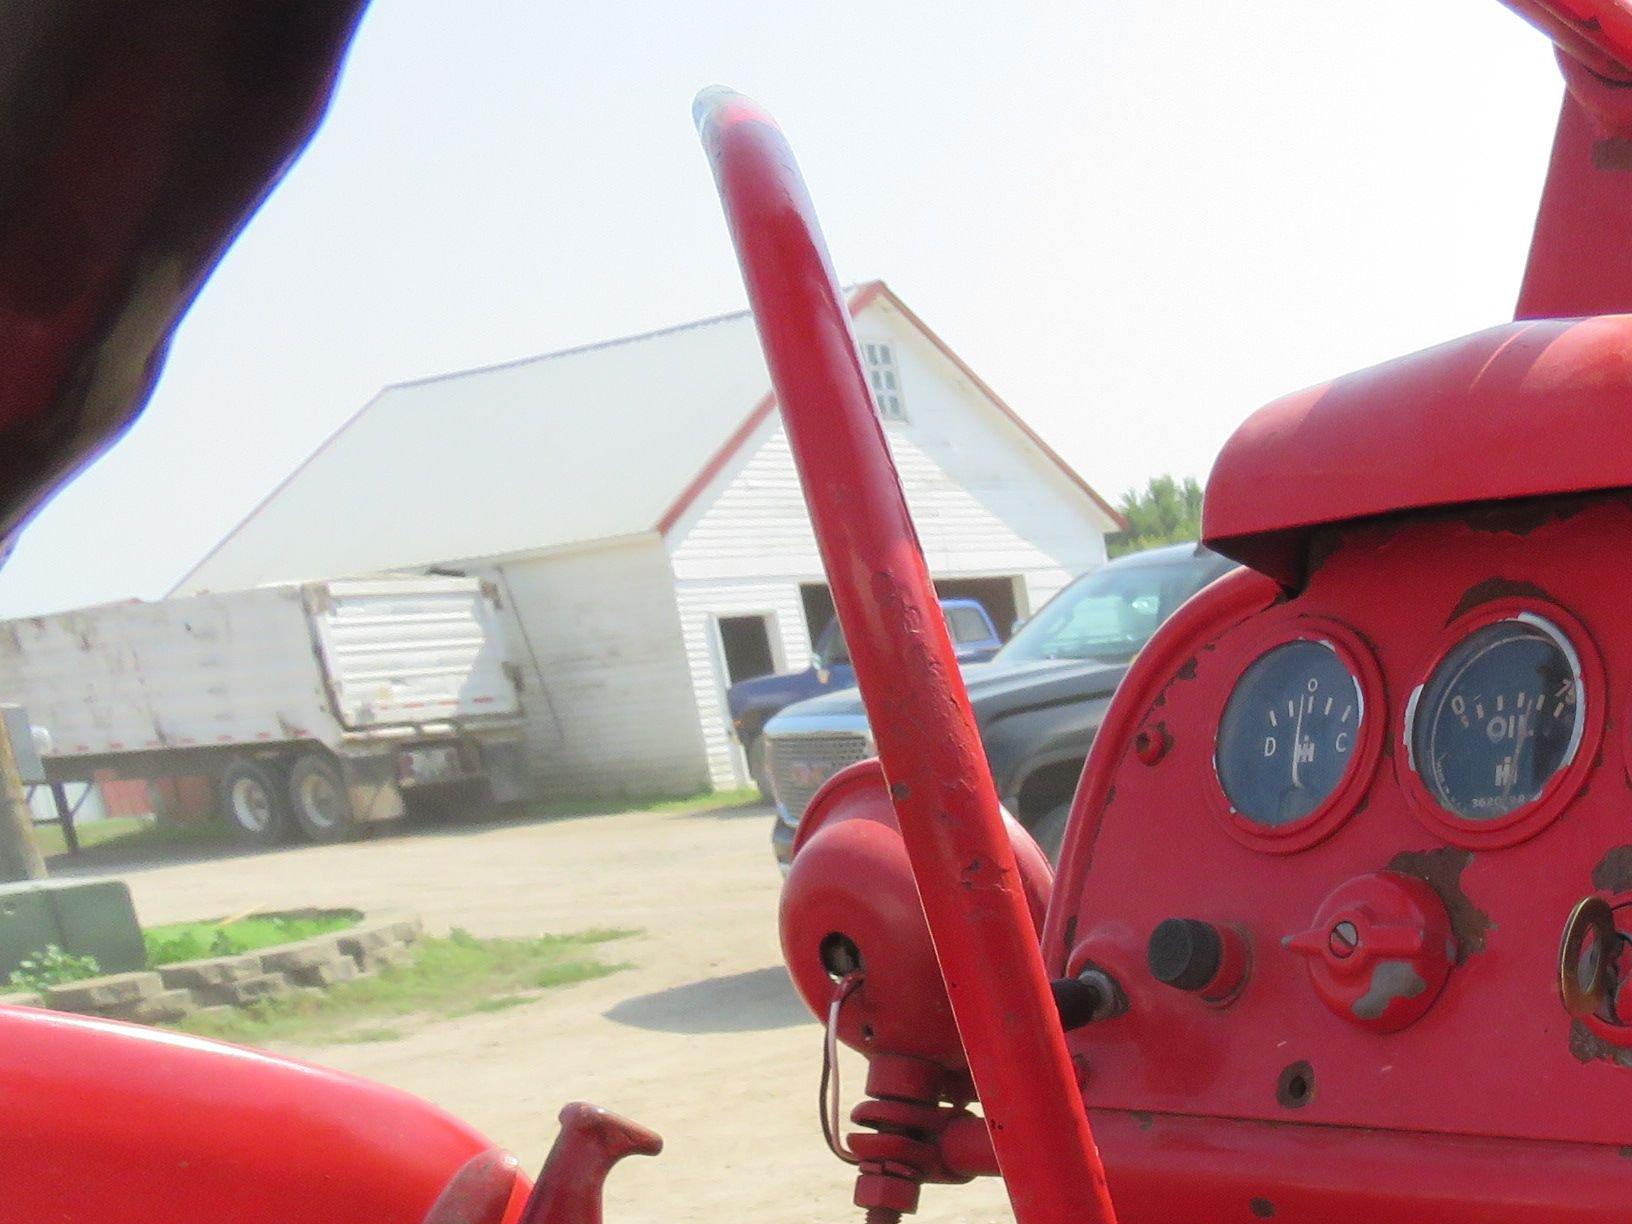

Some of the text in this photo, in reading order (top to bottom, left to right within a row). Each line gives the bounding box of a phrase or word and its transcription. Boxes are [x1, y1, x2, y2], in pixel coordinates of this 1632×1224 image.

[1486, 714, 1535, 744] OIL
[1264, 732, 1347, 757] D C
